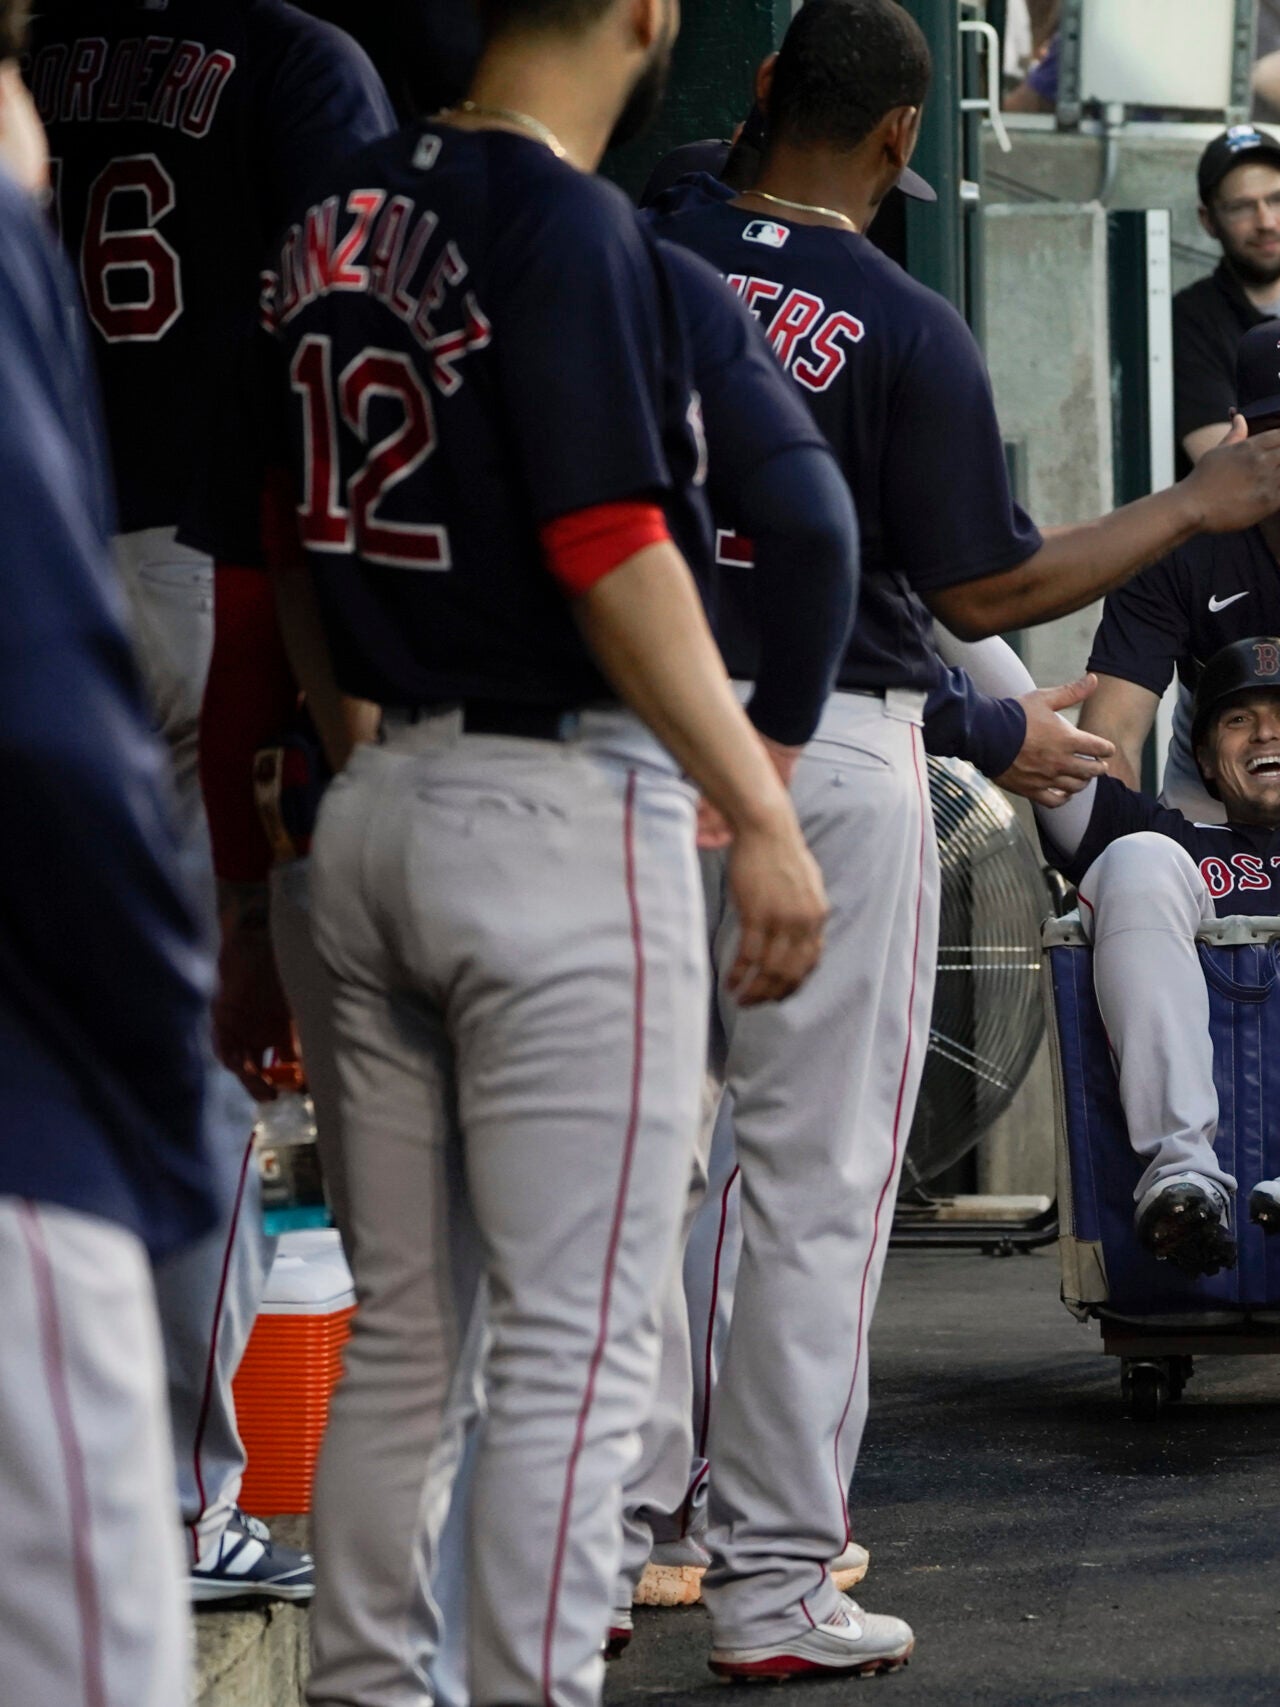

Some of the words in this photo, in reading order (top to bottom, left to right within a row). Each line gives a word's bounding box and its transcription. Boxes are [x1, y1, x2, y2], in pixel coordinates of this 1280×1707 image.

[24, 36, 237, 139] ORDERO
[289, 332, 453, 572] 12
[1253, 644, 1280, 676] B
